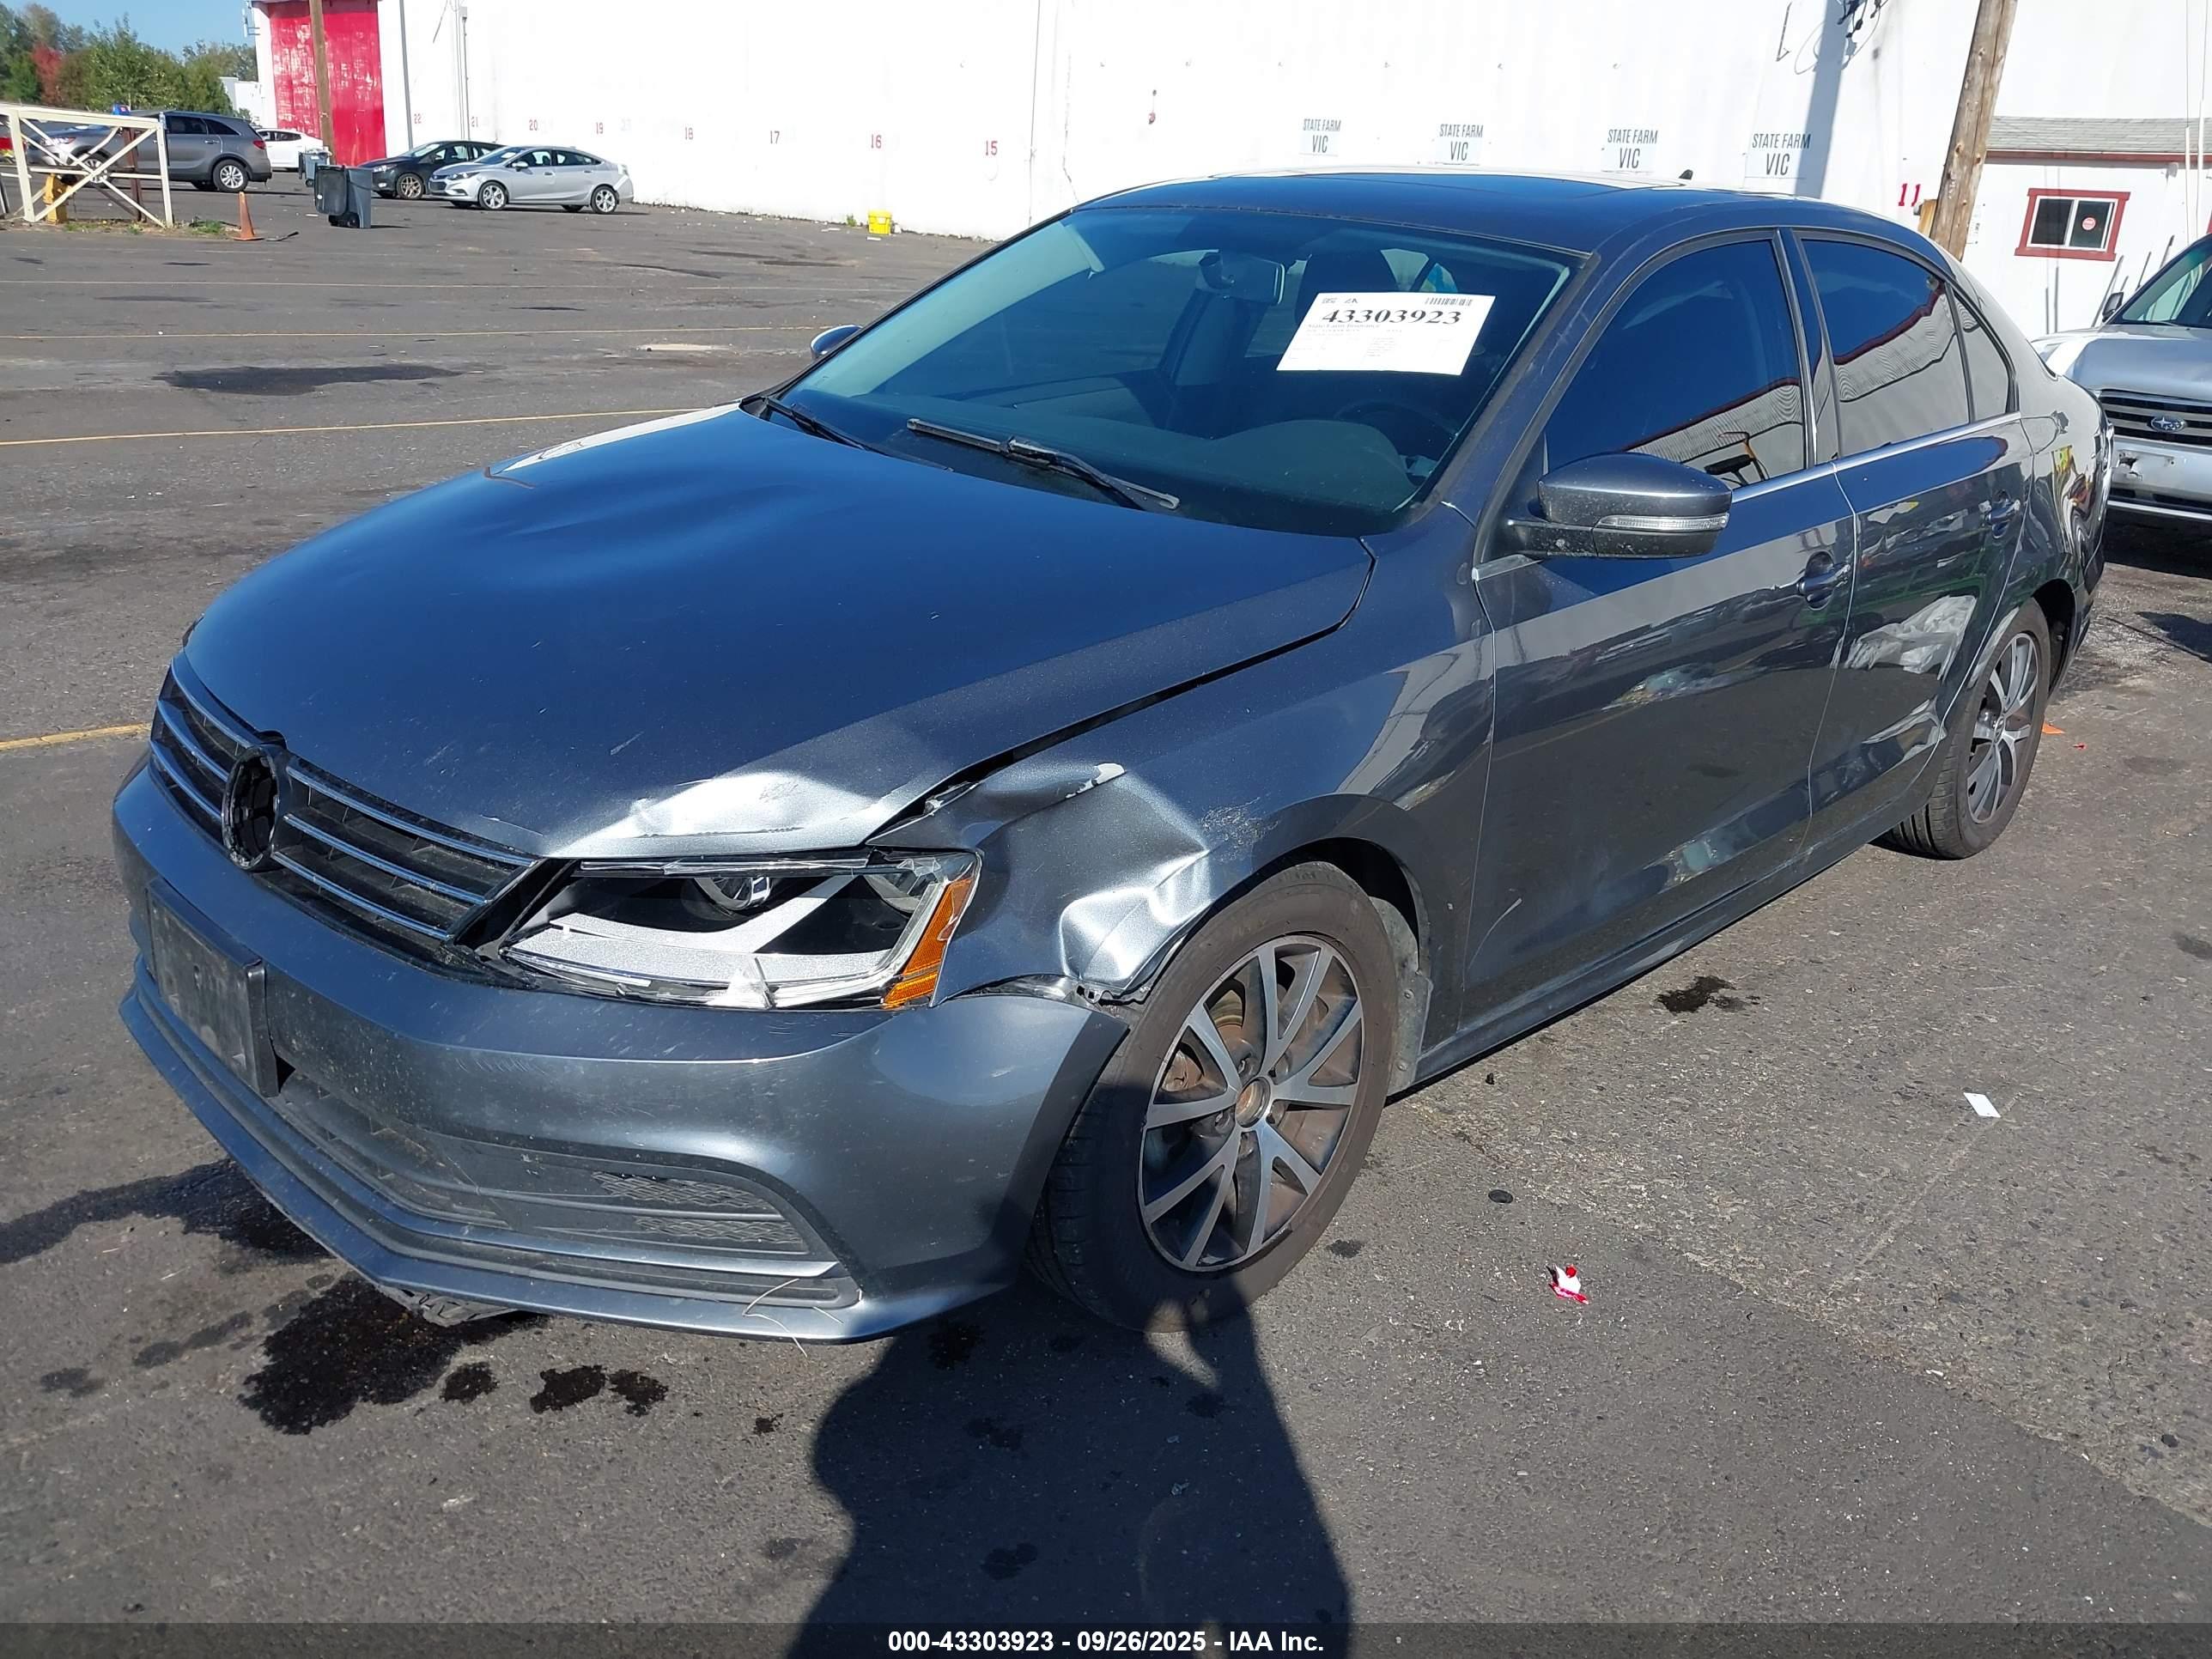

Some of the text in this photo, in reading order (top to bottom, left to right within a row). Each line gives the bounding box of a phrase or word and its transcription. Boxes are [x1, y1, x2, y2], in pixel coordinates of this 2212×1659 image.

[414, 112, 422, 125] 22
[471, 116, 479, 128] 21
[528, 118, 538, 131] 20
[1303, 118, 1342, 132] STATE FARM
[596, 122, 604, 135] 19
[684, 127, 694, 141] 18
[1439, 123, 1484, 138] STATE FARM
[769, 130, 781, 144] 17
[870, 134, 882, 149] 16
[1311, 134, 1328, 154] VIC
[1607, 129, 1658, 144] STATE FARM
[1752, 133, 1811, 149] STATE FARM
[984, 140, 999, 156] 15
[1449, 141, 1469, 161] VIC
[1618, 147, 1641, 169] VIC
[1765, 152, 1790, 176] VIC
[1898, 183, 1921, 207] 11
[1322, 309, 1462, 325] 43303923
